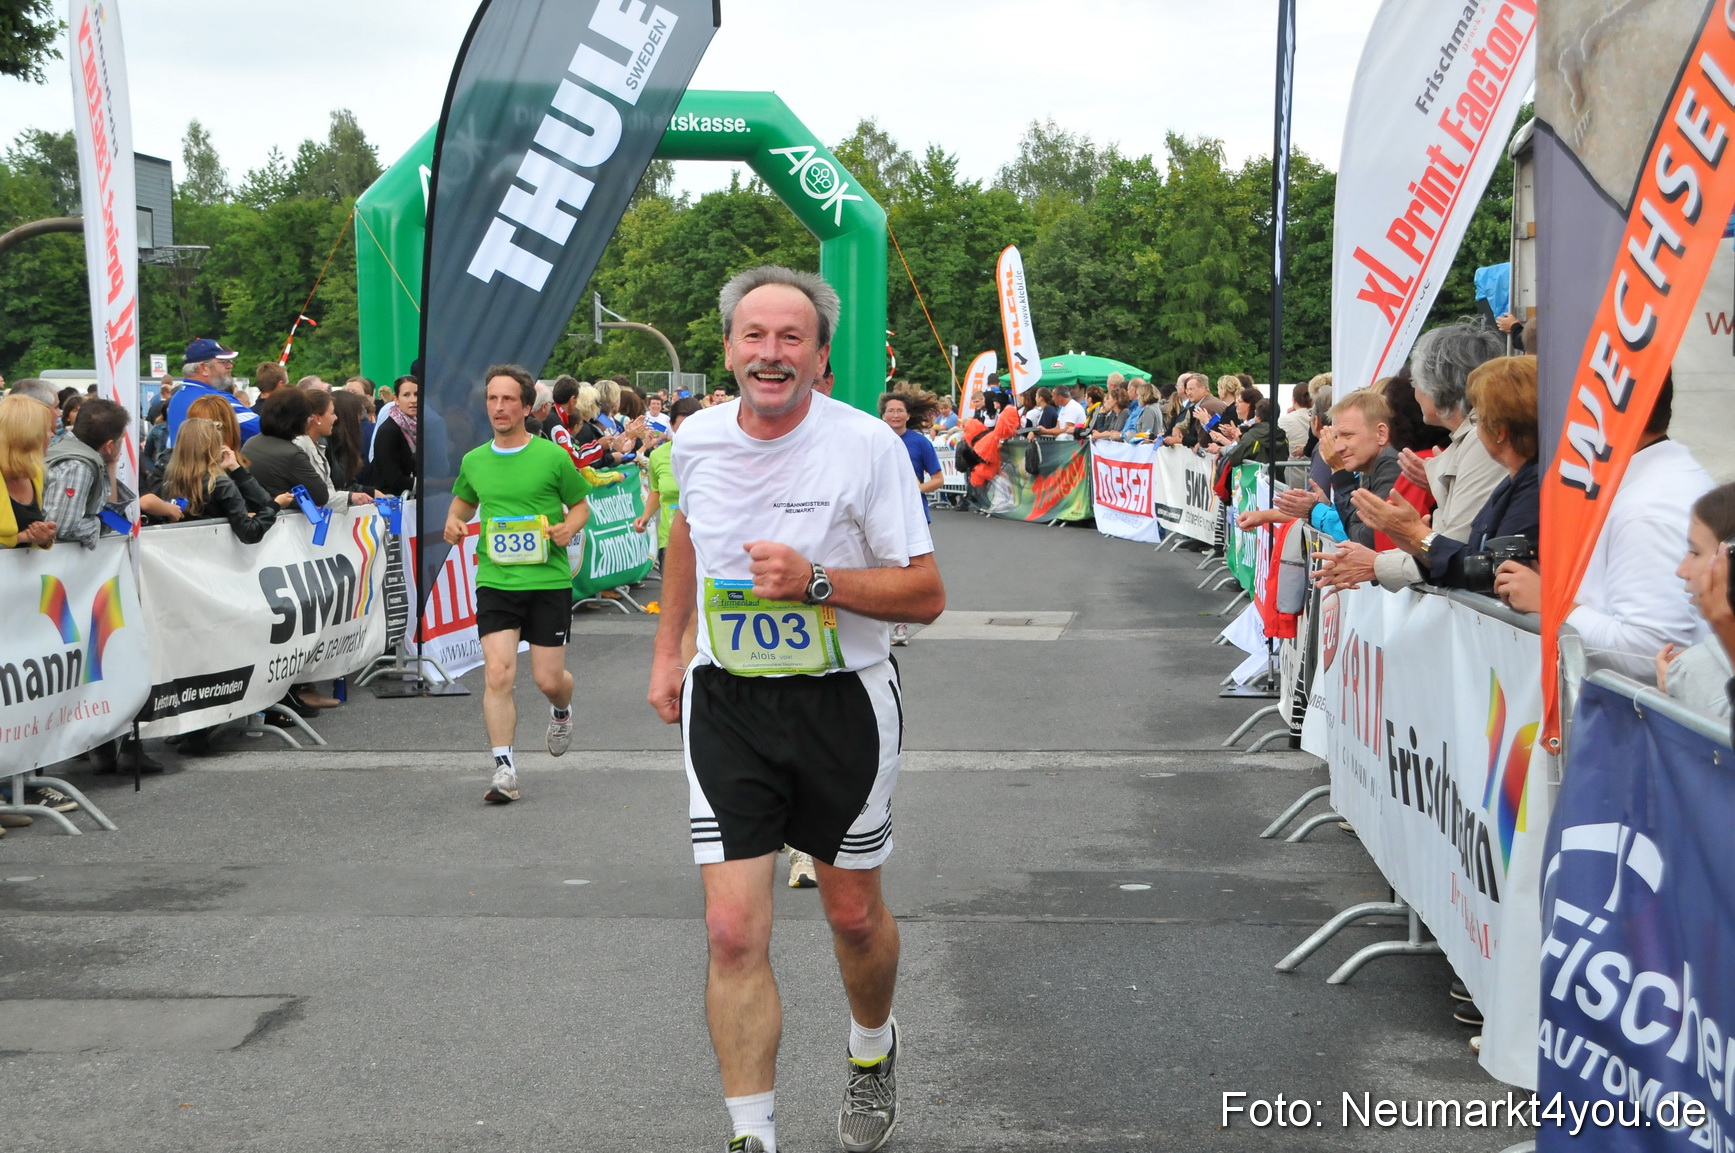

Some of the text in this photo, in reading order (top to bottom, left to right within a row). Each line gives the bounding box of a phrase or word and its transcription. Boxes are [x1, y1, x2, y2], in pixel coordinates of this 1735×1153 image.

[626, 18, 667, 90] SWEDEN
[467, 0, 680, 292] THULE
[769, 144, 864, 227] AOK
[1385, 144, 1465, 265] Print
[1096, 461, 1150, 514] MEIER
[494, 532, 536, 553] 838
[720, 612, 811, 651] 703
[750, 651, 776, 661] Alois
[181, 687, 197, 702] die
[198, 679, 244, 700] verbinden
[0, 715, 39, 744] ruck
[56, 699, 111, 728] Medien
